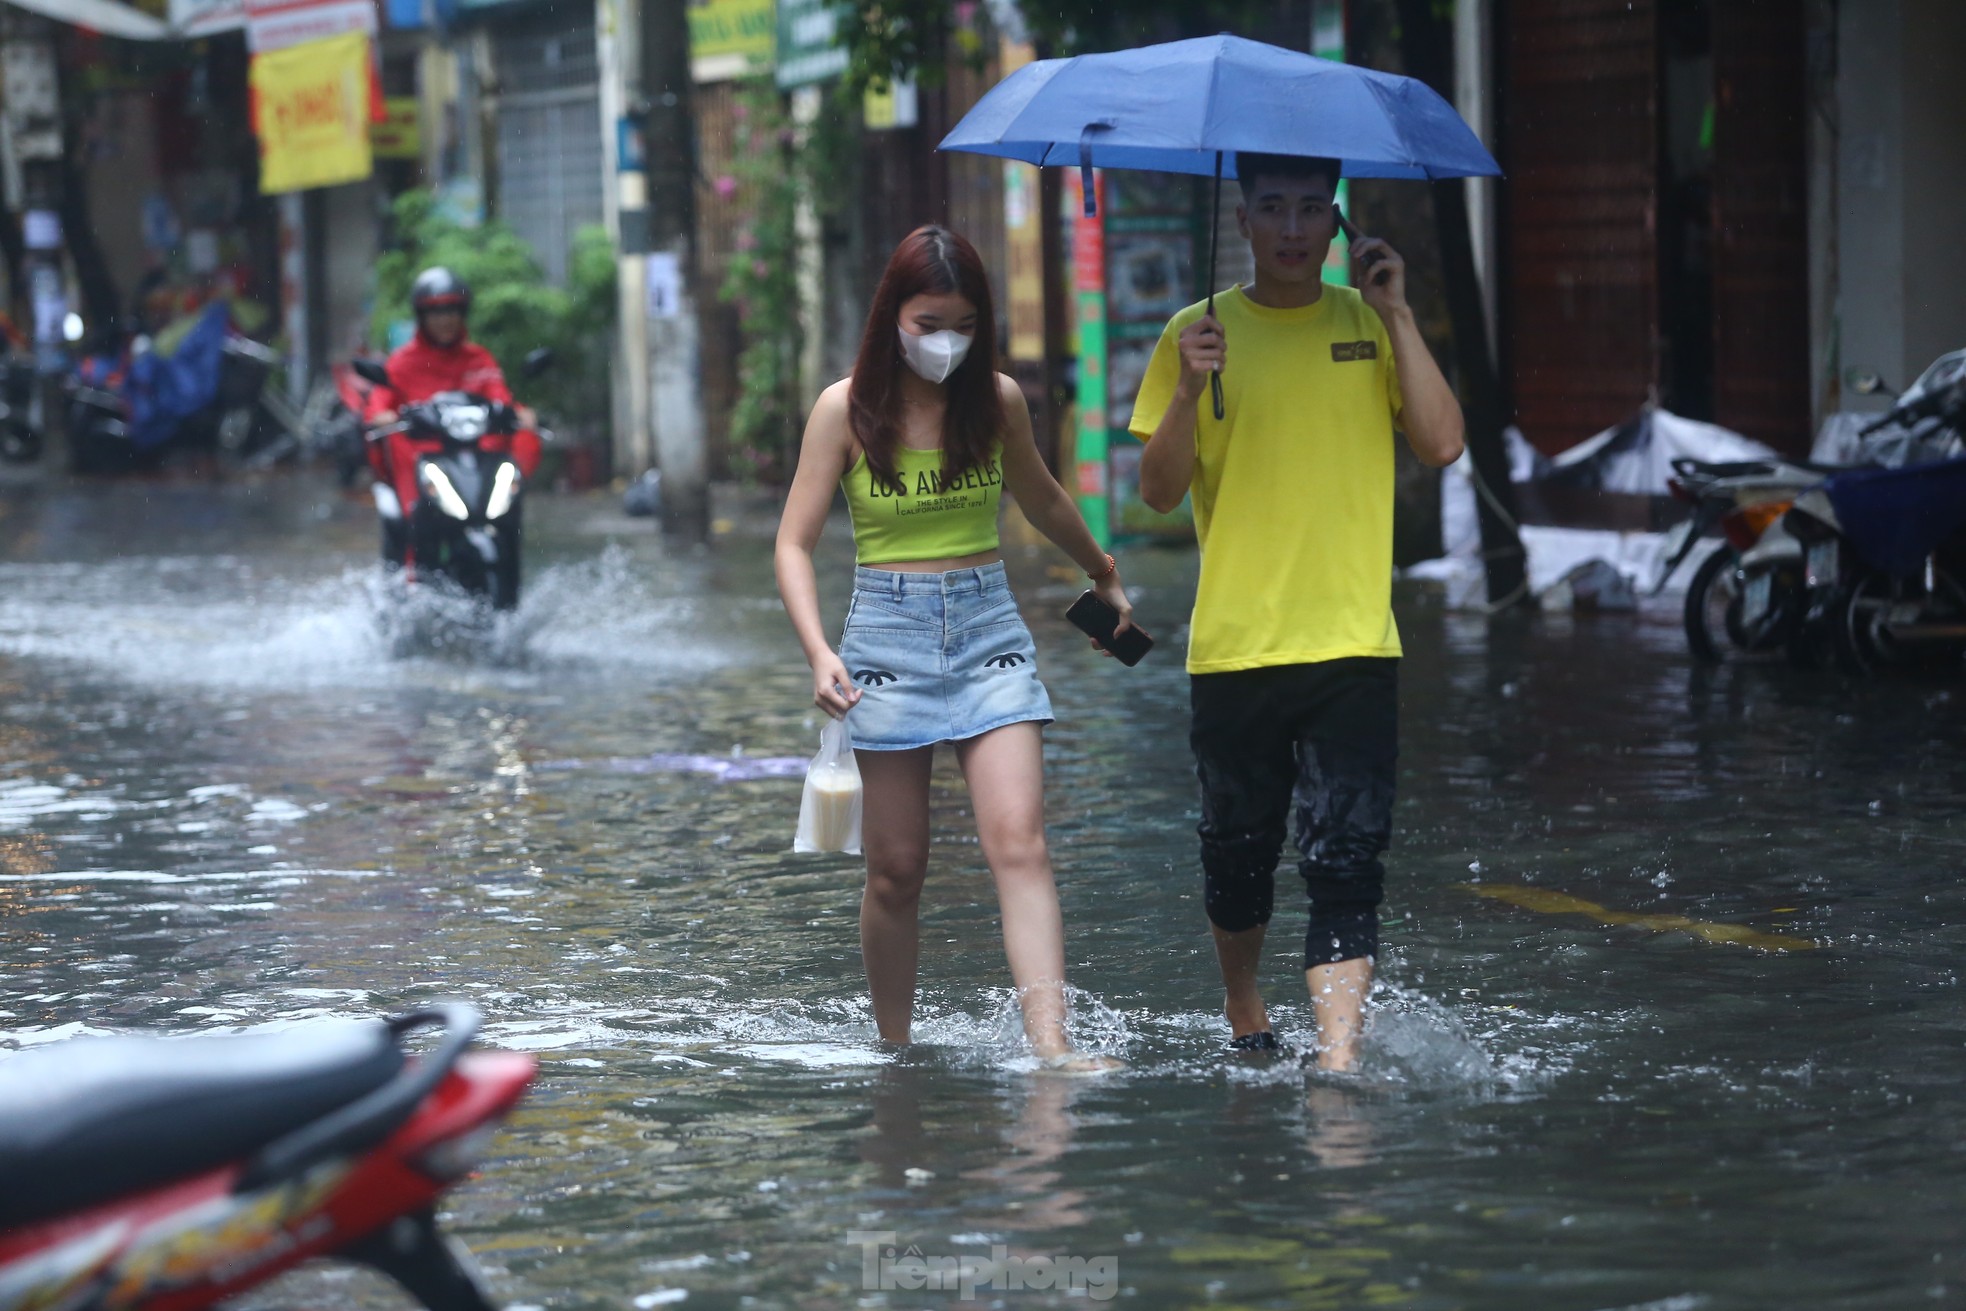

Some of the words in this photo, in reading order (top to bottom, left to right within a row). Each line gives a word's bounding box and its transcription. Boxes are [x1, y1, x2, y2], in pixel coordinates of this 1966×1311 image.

[870, 470, 908, 498] LOS
[916, 459, 1001, 496] ANGELES
[916, 499, 932, 507] THE
[934, 496, 958, 504] STYLE
[900, 505, 944, 516] CALIFORNIA
[945, 502, 966, 510] SINCE
